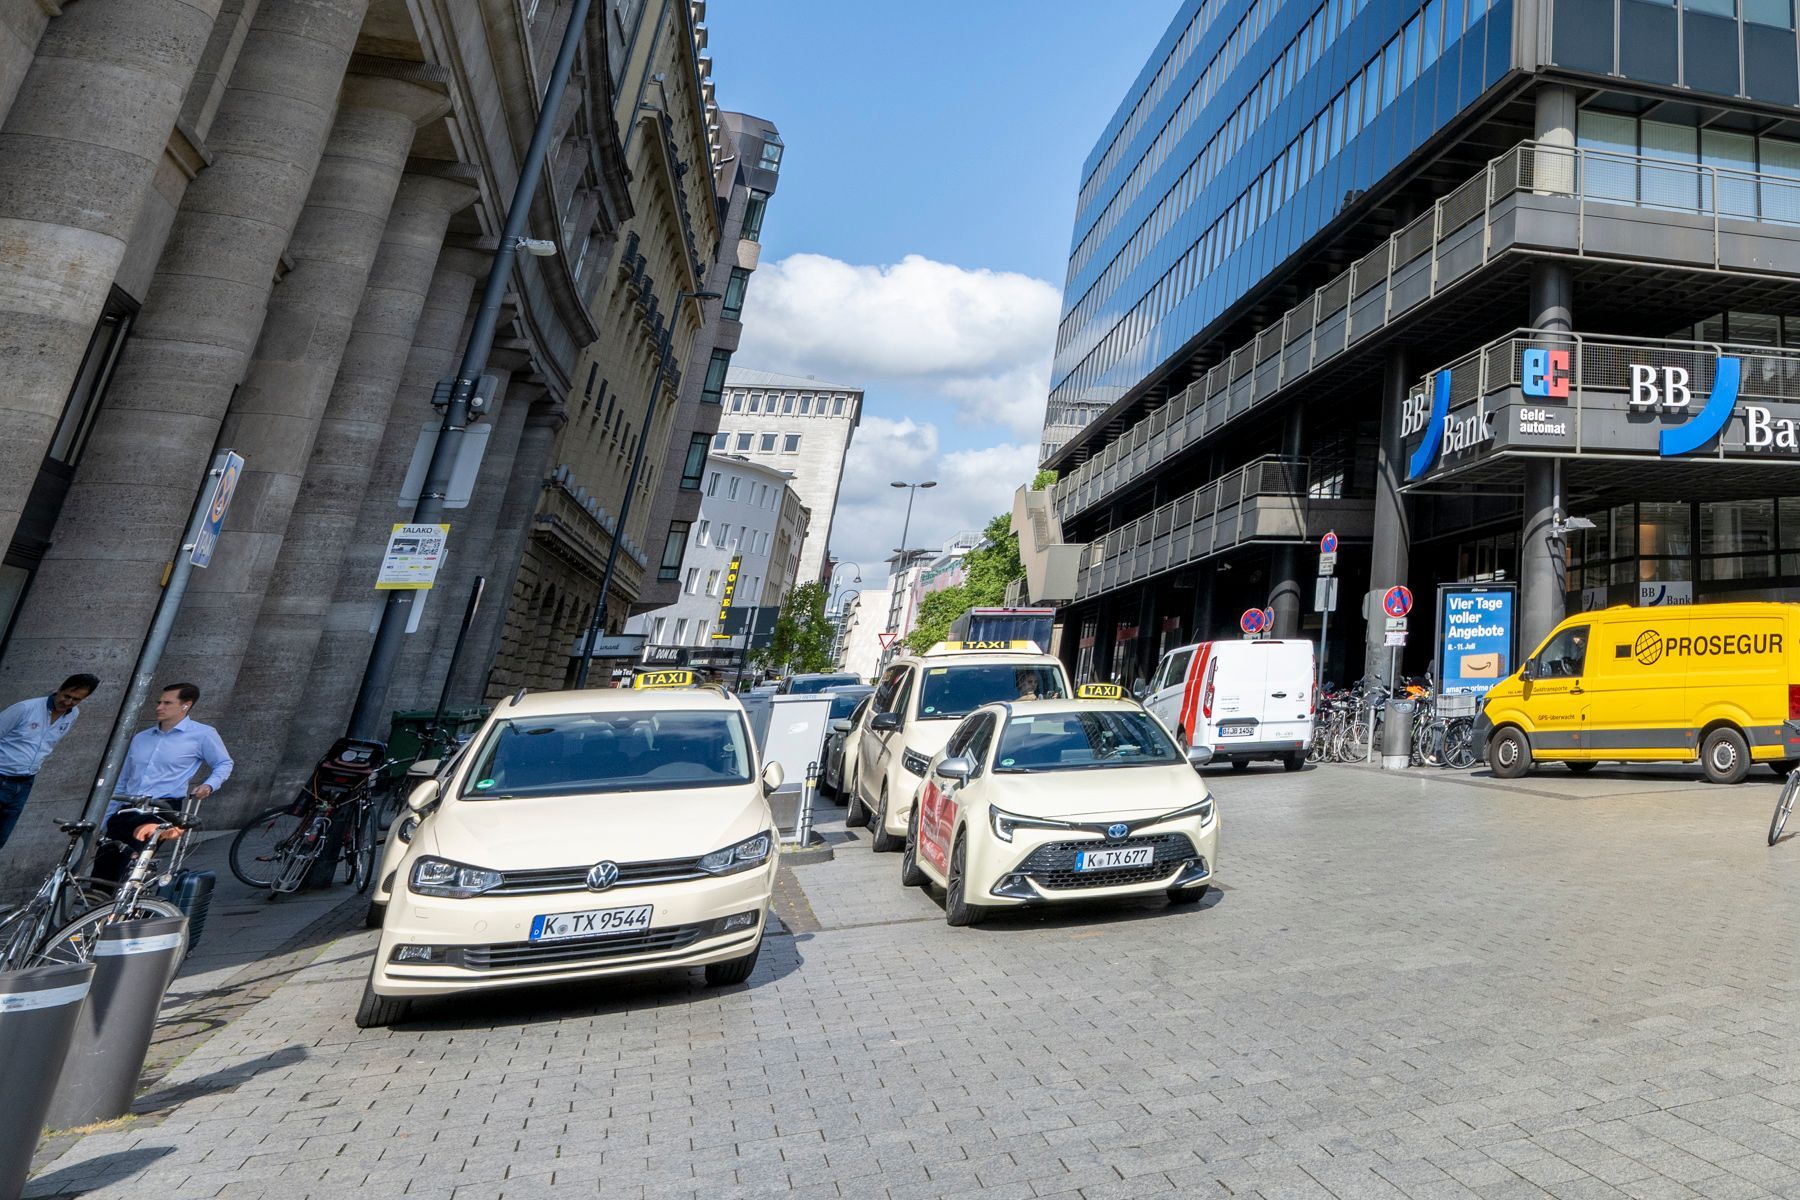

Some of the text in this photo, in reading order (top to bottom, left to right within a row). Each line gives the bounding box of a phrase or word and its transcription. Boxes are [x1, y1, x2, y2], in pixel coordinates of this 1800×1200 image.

[1629, 364, 1692, 407] BB
[1400, 393, 1424, 438] BB
[1519, 408, 1554, 421] Geld-
[1440, 397, 1490, 456] Bank
[1519, 421, 1566, 435] automat
[719, 561, 740, 620] HOTEL
[1642, 587, 1655, 598] BB
[1449, 597, 1504, 611] Vier Tage
[1667, 595, 1691, 605] Bank
[1448, 611, 1482, 624] voller
[1447, 624, 1505, 639] Angebote
[966, 640, 1005, 649] TAXI
[1665, 633, 1783, 657] PROSEGUR
[647, 672, 683, 684] TAXI
[1087, 686, 1115, 696] TAXI
[1087, 854, 1097, 867] K
[1106, 851, 1122, 865] TX
[1124, 849, 1148, 864] 677
[543, 917, 559, 935] K
[572, 913, 597, 932] TX
[600, 908, 648, 930] 9544
